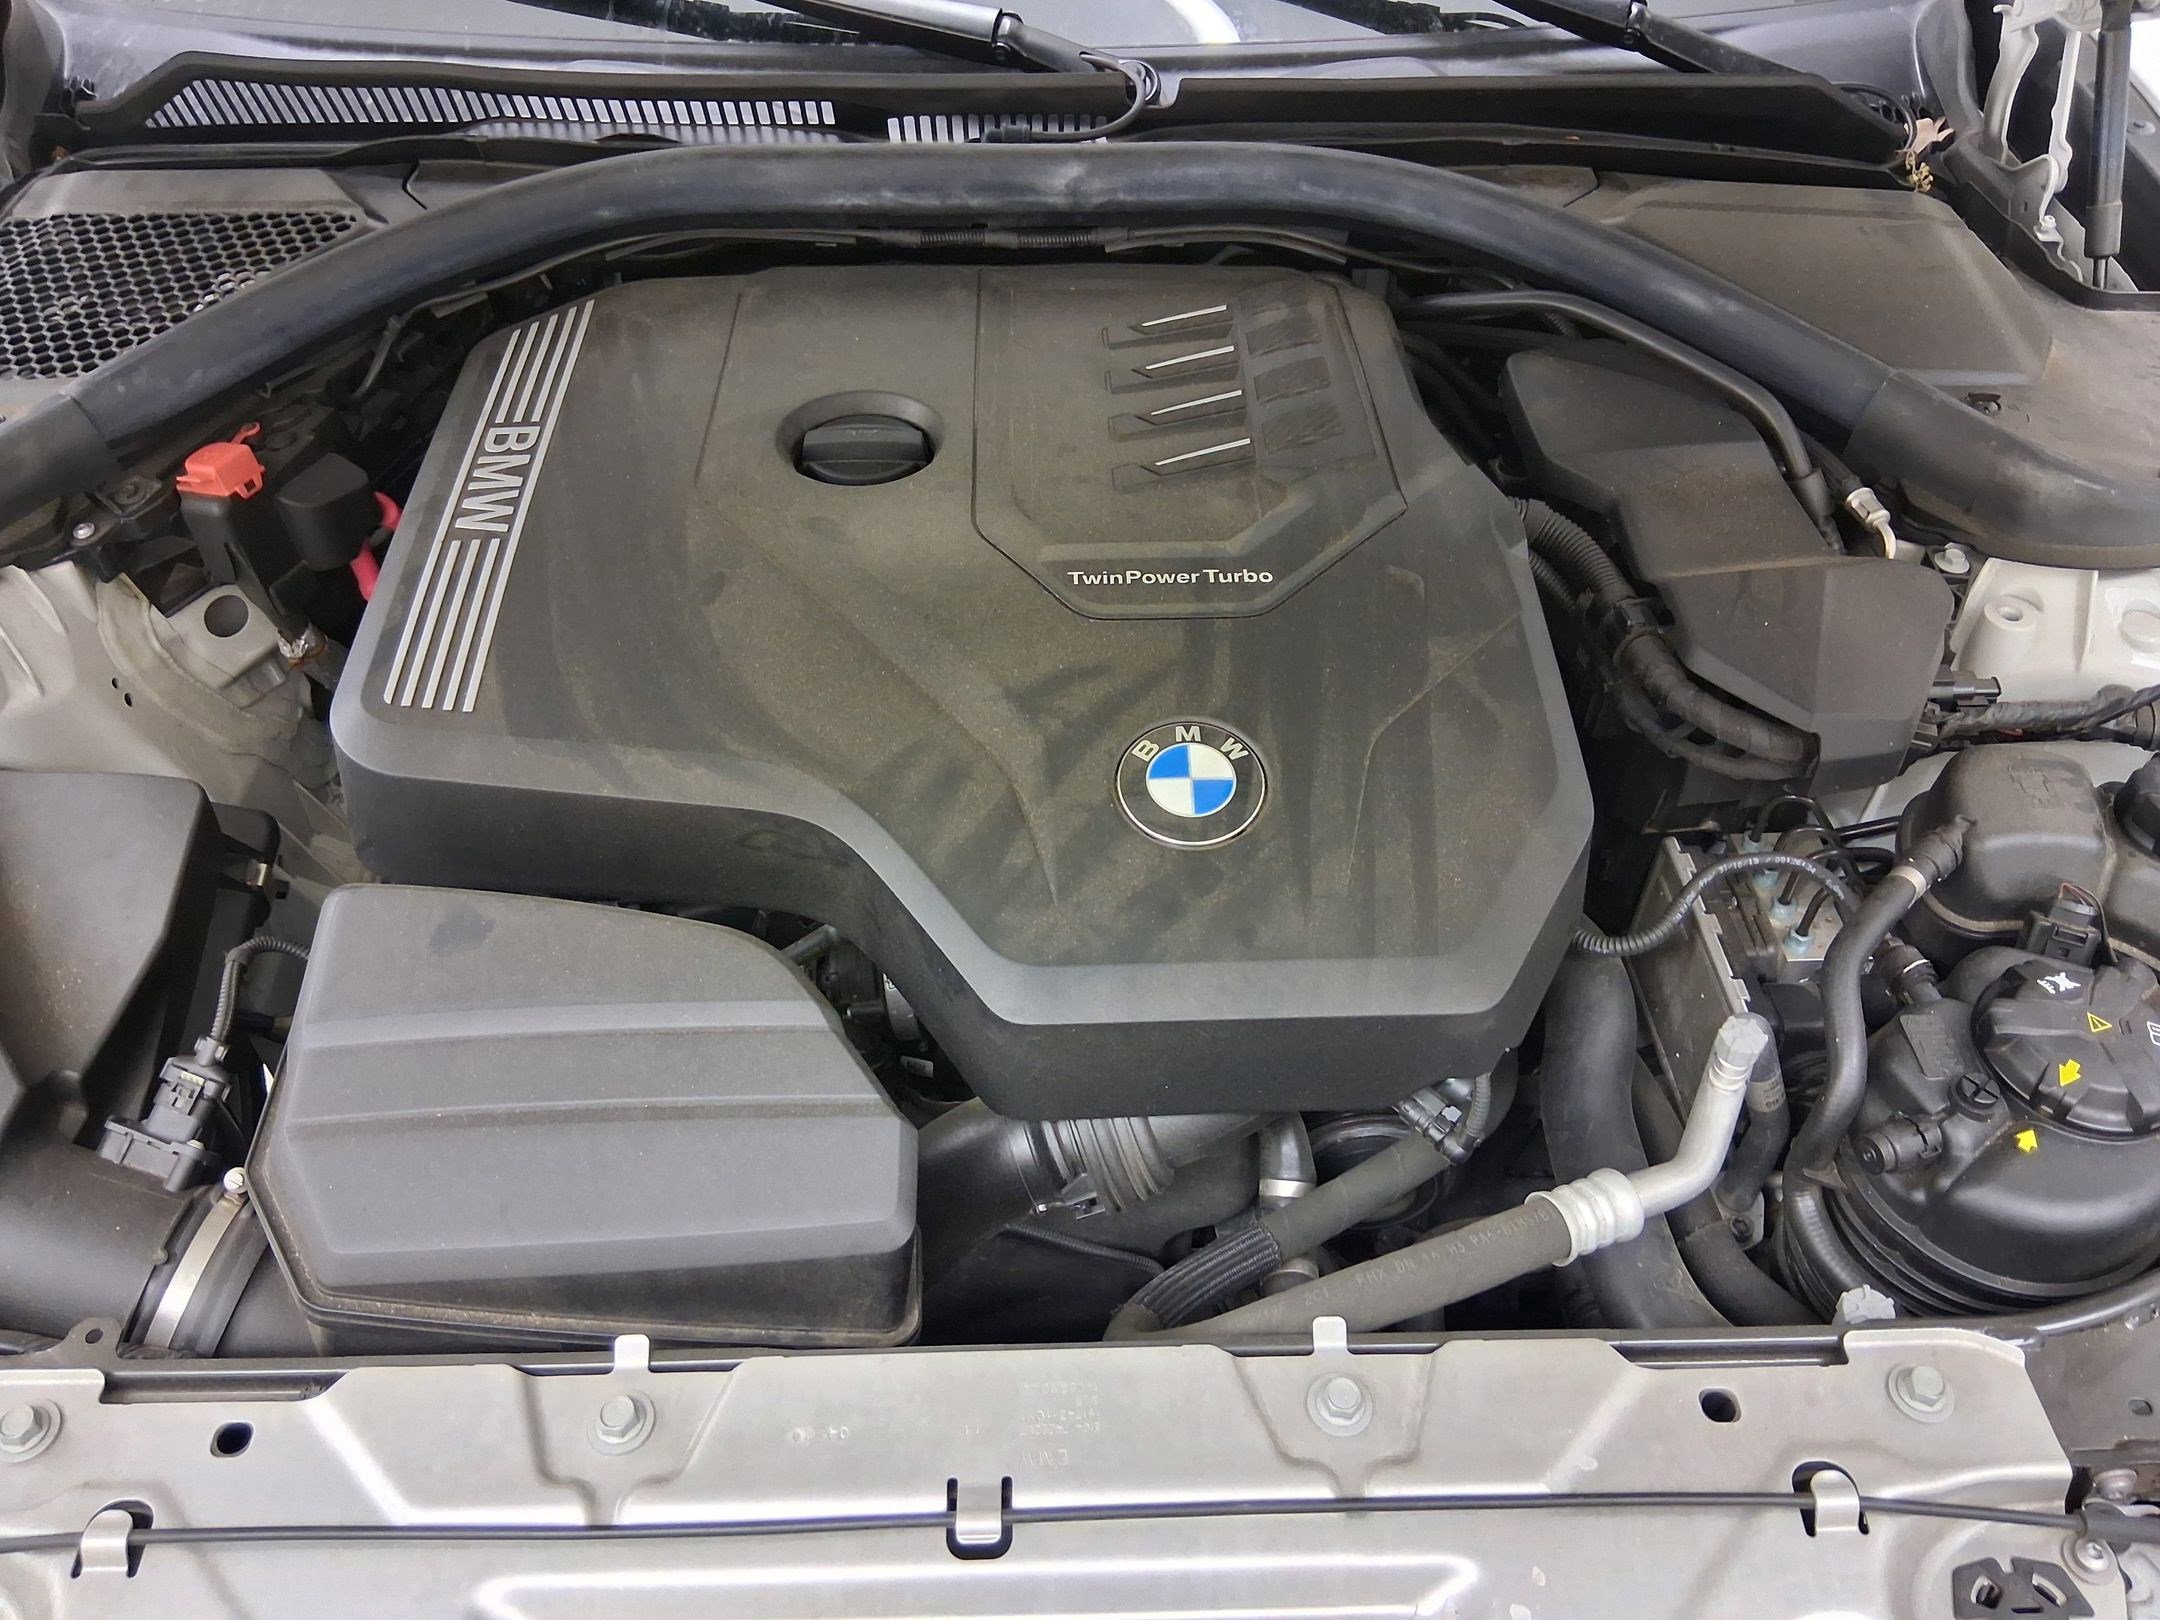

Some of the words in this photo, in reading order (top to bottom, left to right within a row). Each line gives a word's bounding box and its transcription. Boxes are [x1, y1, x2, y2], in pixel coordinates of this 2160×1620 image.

[455, 426, 541, 532] BMW
[1067, 570, 1200, 585] TwinPower
[1202, 569, 1274, 583] Turbo
[1131, 725, 1250, 762] BMW
